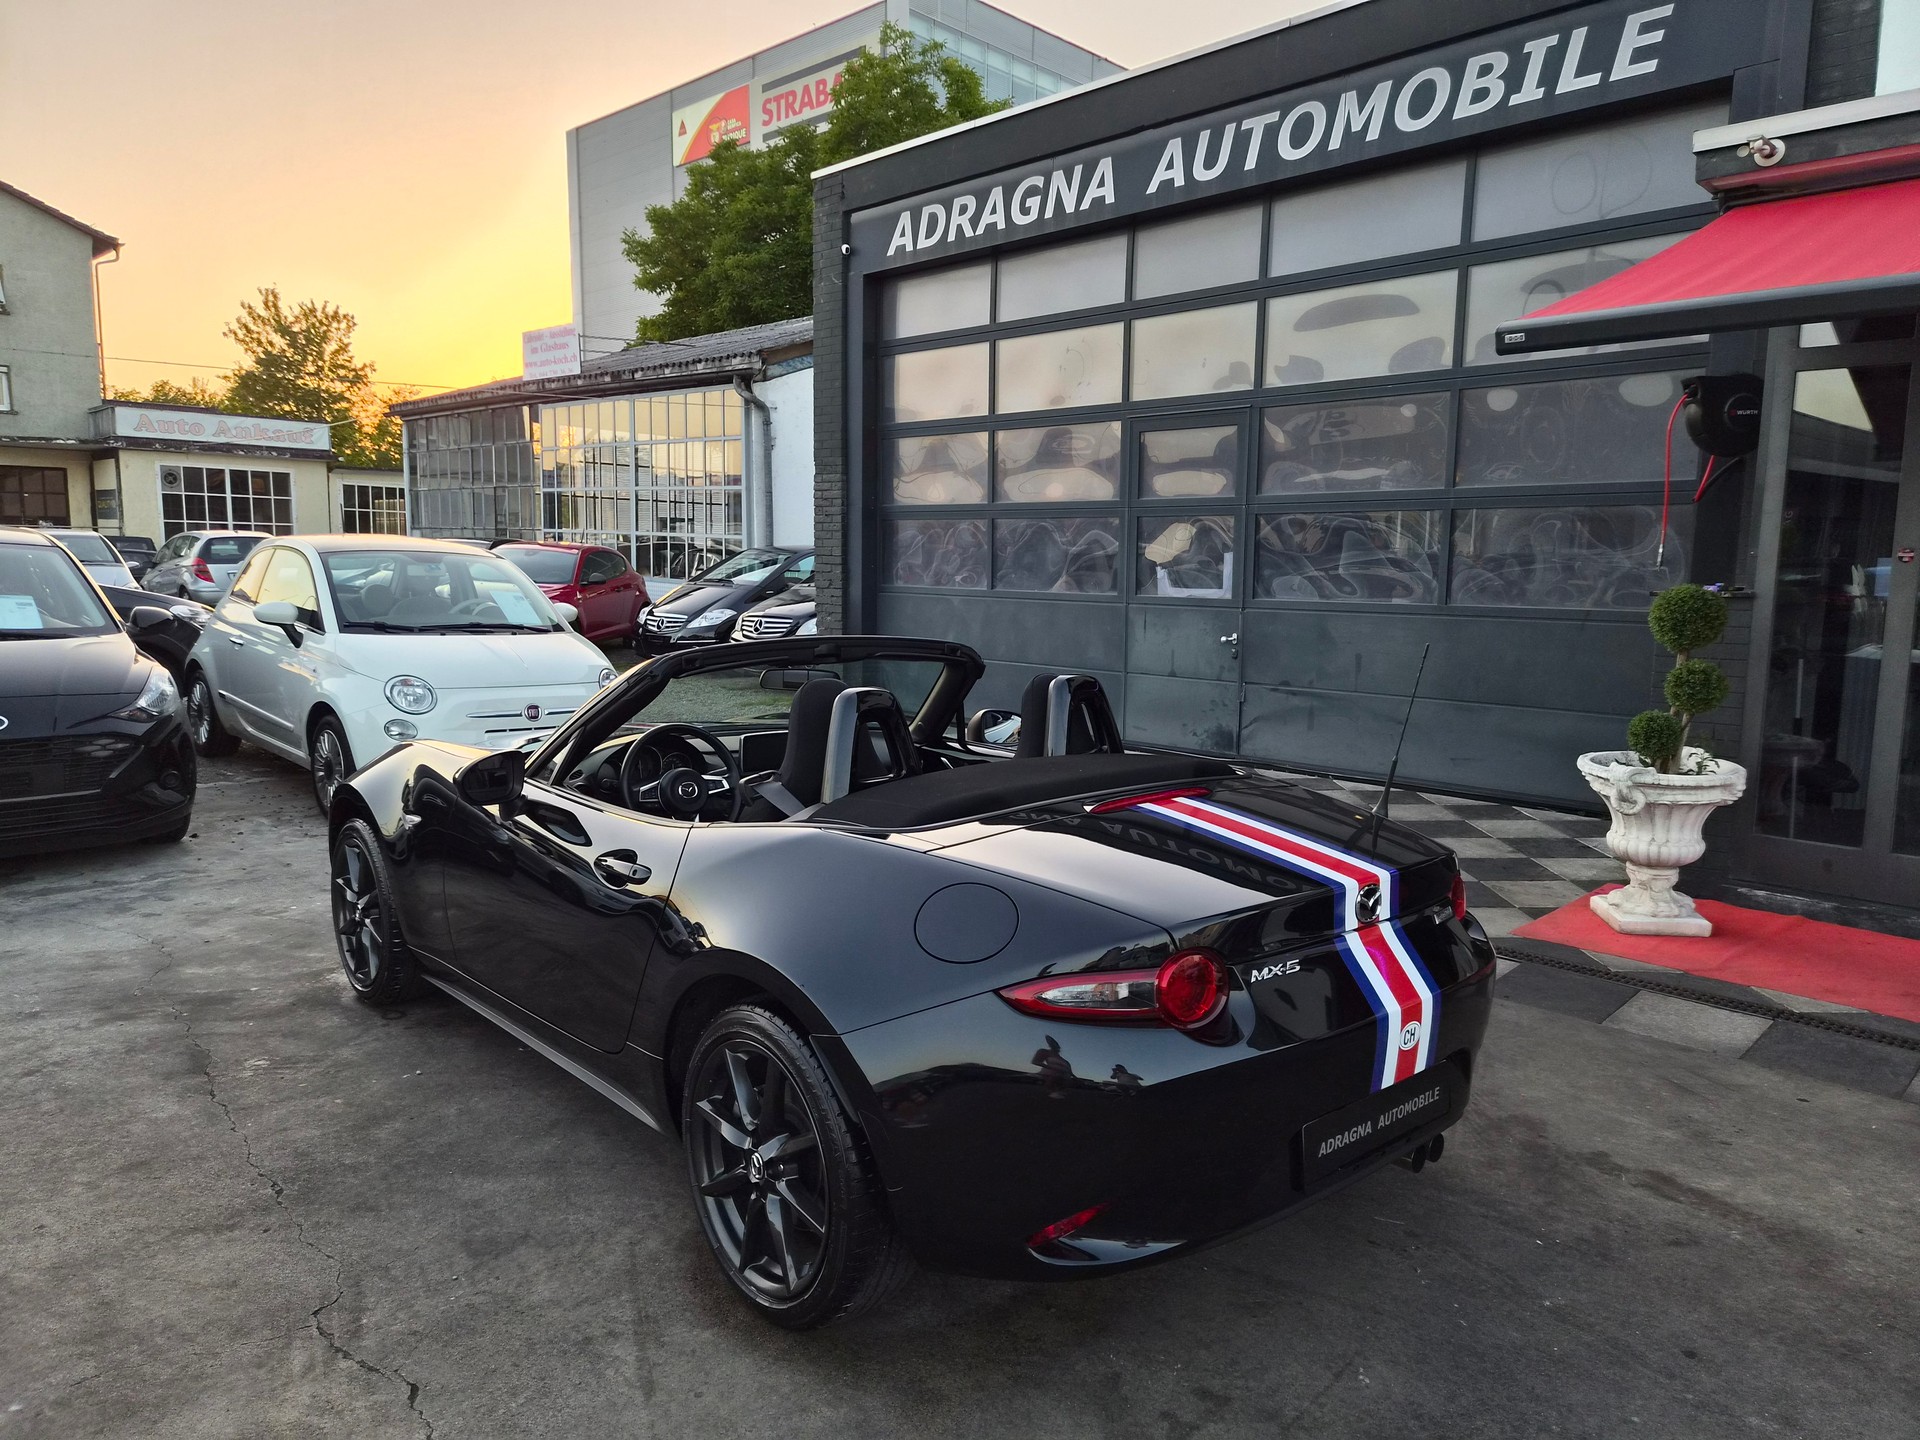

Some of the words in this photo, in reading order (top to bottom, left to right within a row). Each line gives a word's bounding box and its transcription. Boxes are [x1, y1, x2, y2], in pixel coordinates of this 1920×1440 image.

[887, 156, 1115, 256] ADRAGNA
[1146, 3, 1675, 194] AUTOMOBILE
[133, 413, 206, 436] Auto
[211, 419, 315, 445] Ankauf
[1250, 959, 1301, 984] MX-5
[1403, 1026, 1416, 1046] CH
[1318, 1120, 1372, 1158] ADRAGNA
[1378, 1086, 1441, 1130] AUTOMOBILE
